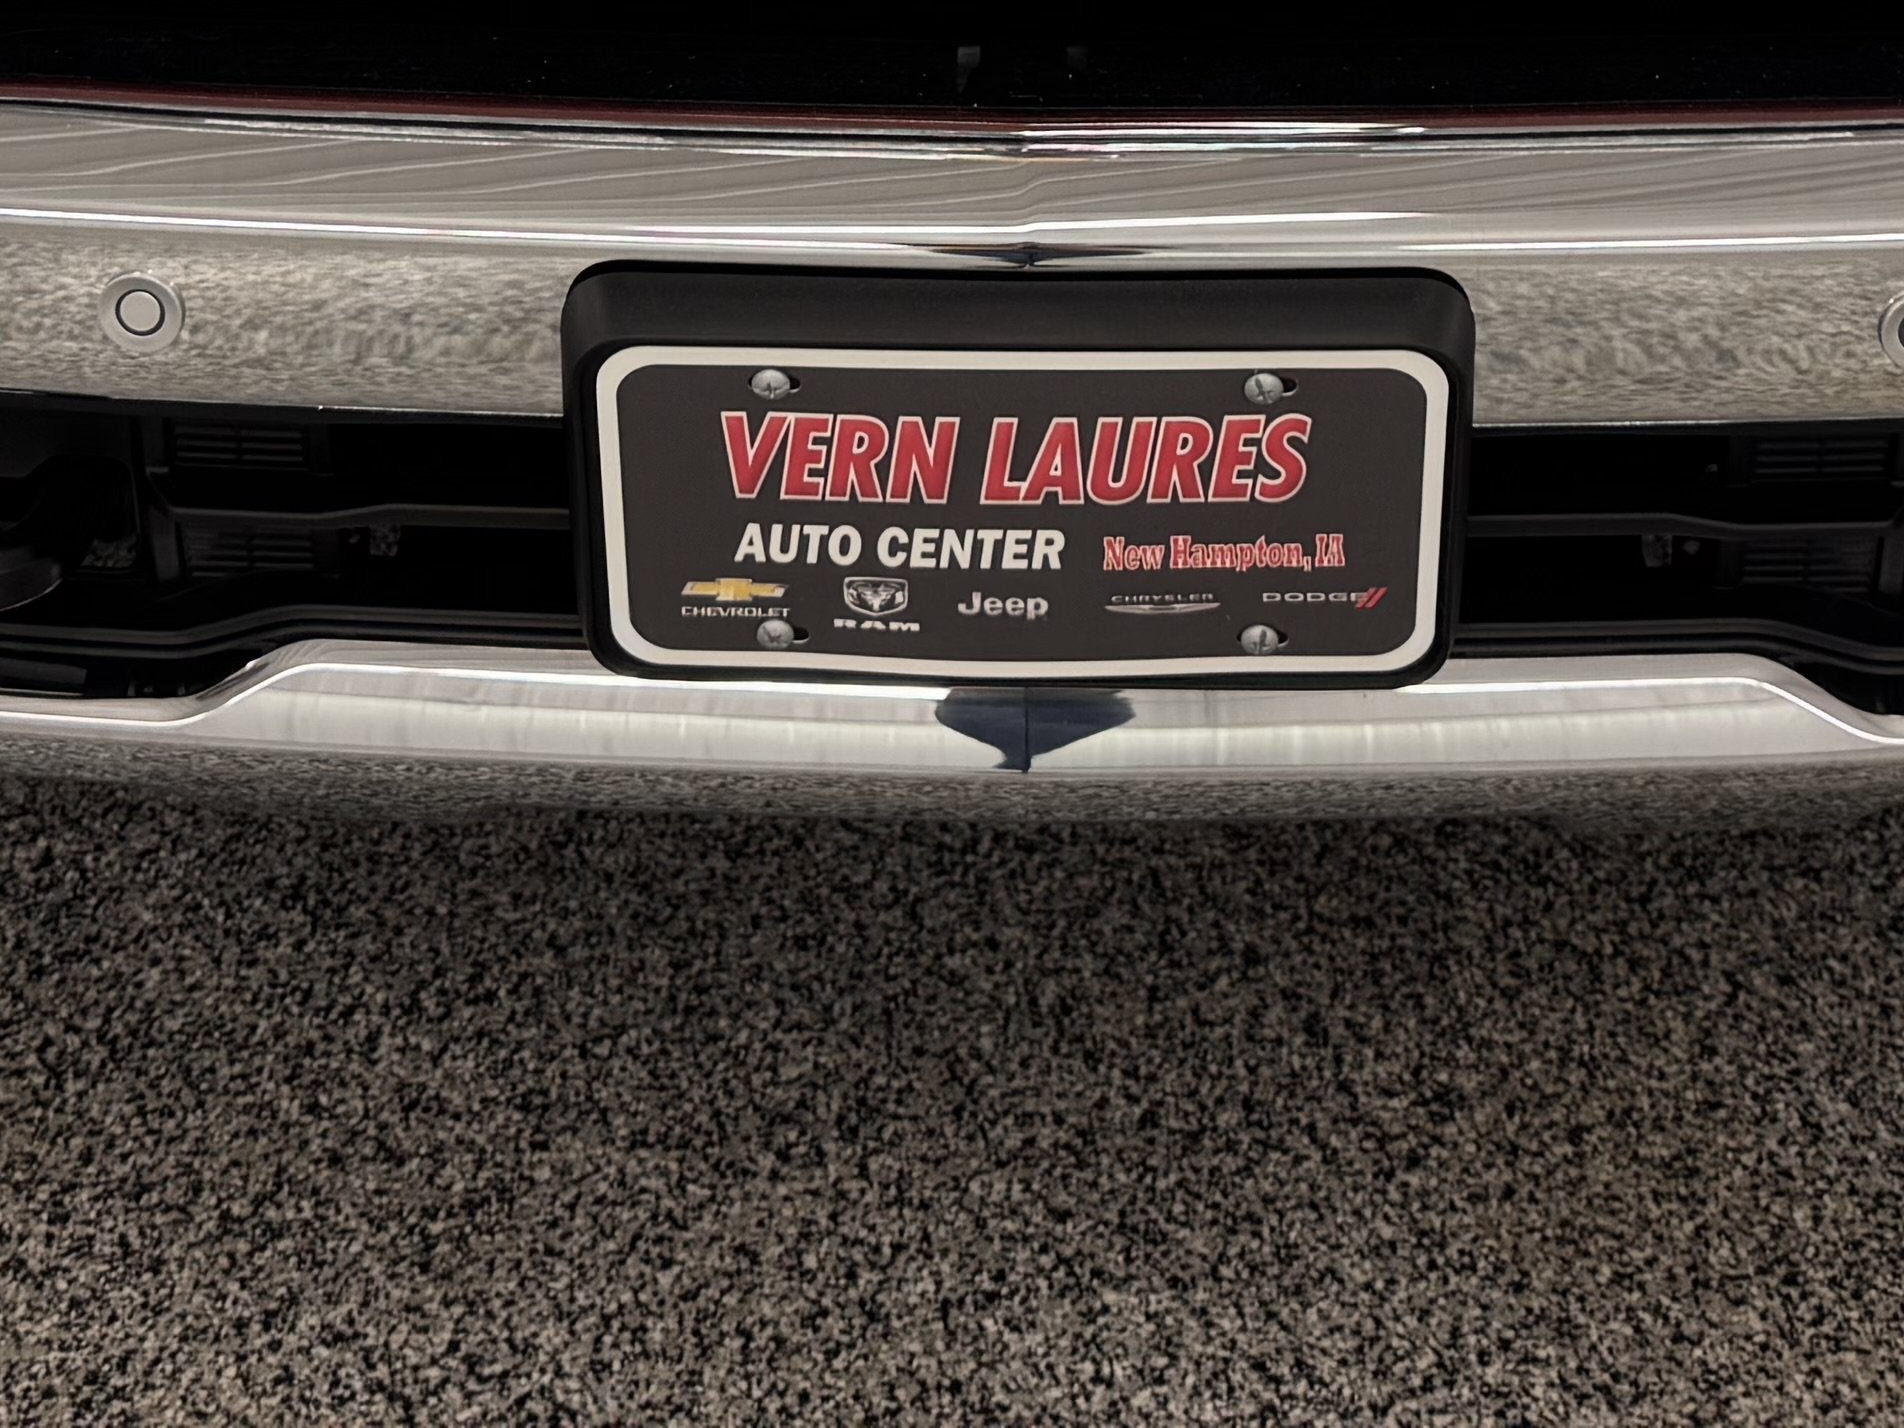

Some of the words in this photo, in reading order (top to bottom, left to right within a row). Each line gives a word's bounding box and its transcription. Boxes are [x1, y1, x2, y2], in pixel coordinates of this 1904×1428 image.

[720, 410, 960, 503] VERN
[978, 412, 1313, 505] LAURES
[734, 522, 862, 566] AUTO
[876, 525, 1066, 570] CENTER
[1102, 536, 1166, 571] New
[1170, 534, 1312, 572] Hampton,
[1314, 533, 1346, 567] IA
[957, 591, 1049, 620] Jeep
[1110, 592, 1215, 603] CHRYSLER
[1262, 592, 1369, 602] DODGE
[680, 605, 791, 618] CHEVROLET
[832, 618, 921, 633] RAM
